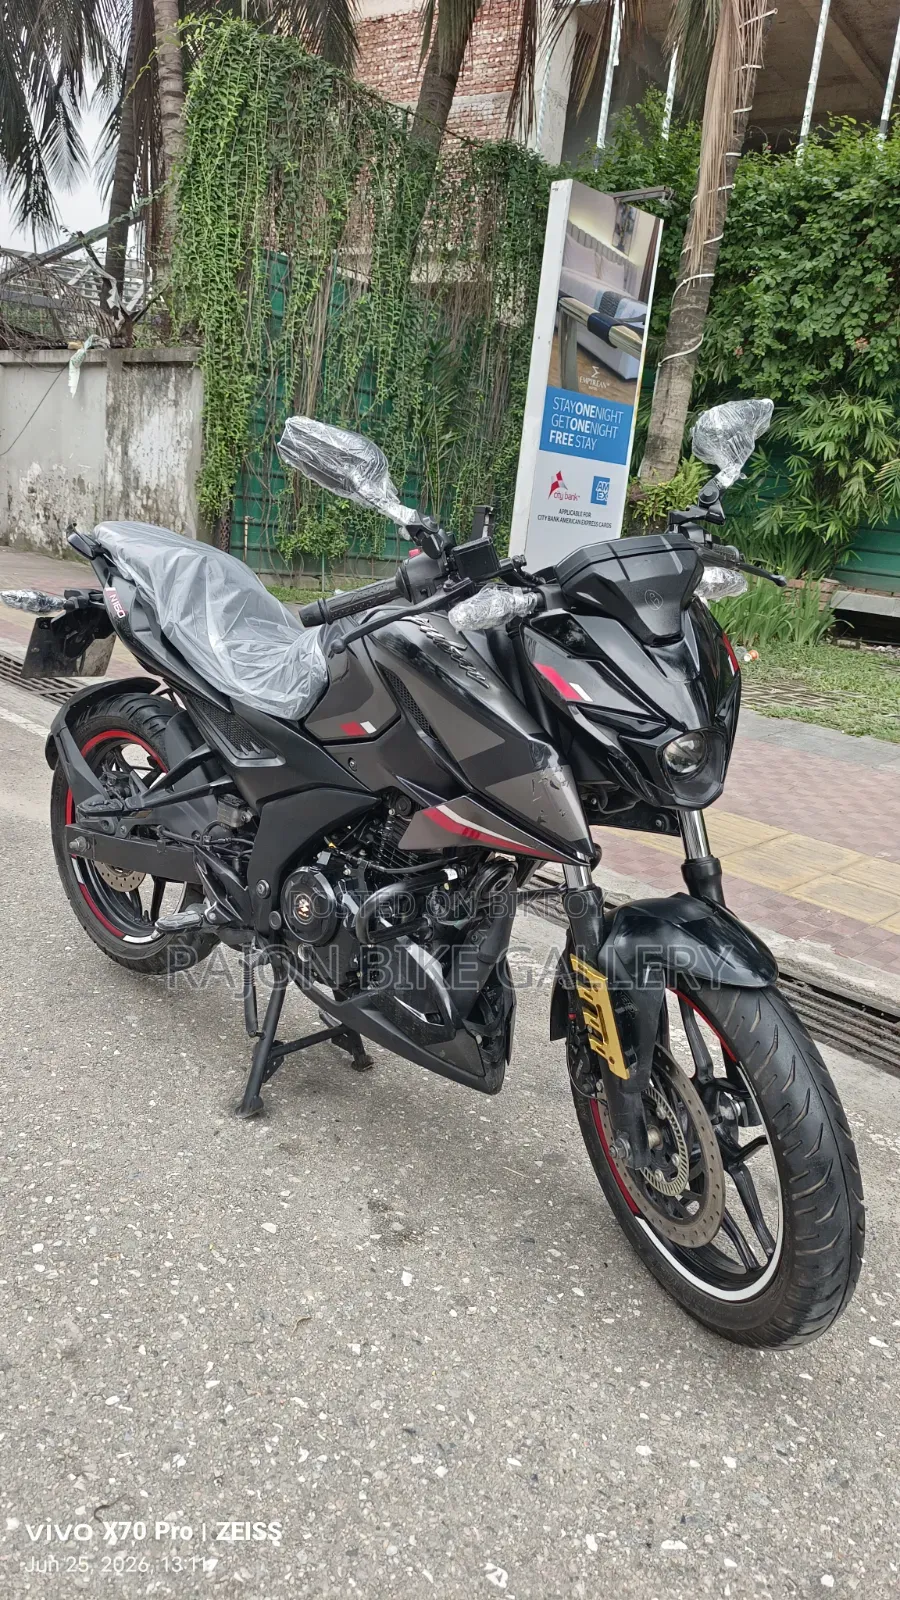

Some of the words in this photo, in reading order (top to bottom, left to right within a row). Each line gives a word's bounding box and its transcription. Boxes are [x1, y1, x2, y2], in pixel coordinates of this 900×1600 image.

[552, 396, 624, 424] STAYONENIGHT
[551, 414, 619, 438] GETONENIGHT
[549, 430, 574, 446] FREE
[574, 436, 598, 450] STAY
[554, 491, 564, 500] city
[558, 508, 582, 517] APPLICABLE
[560, 517, 580, 525] AMERICAN
